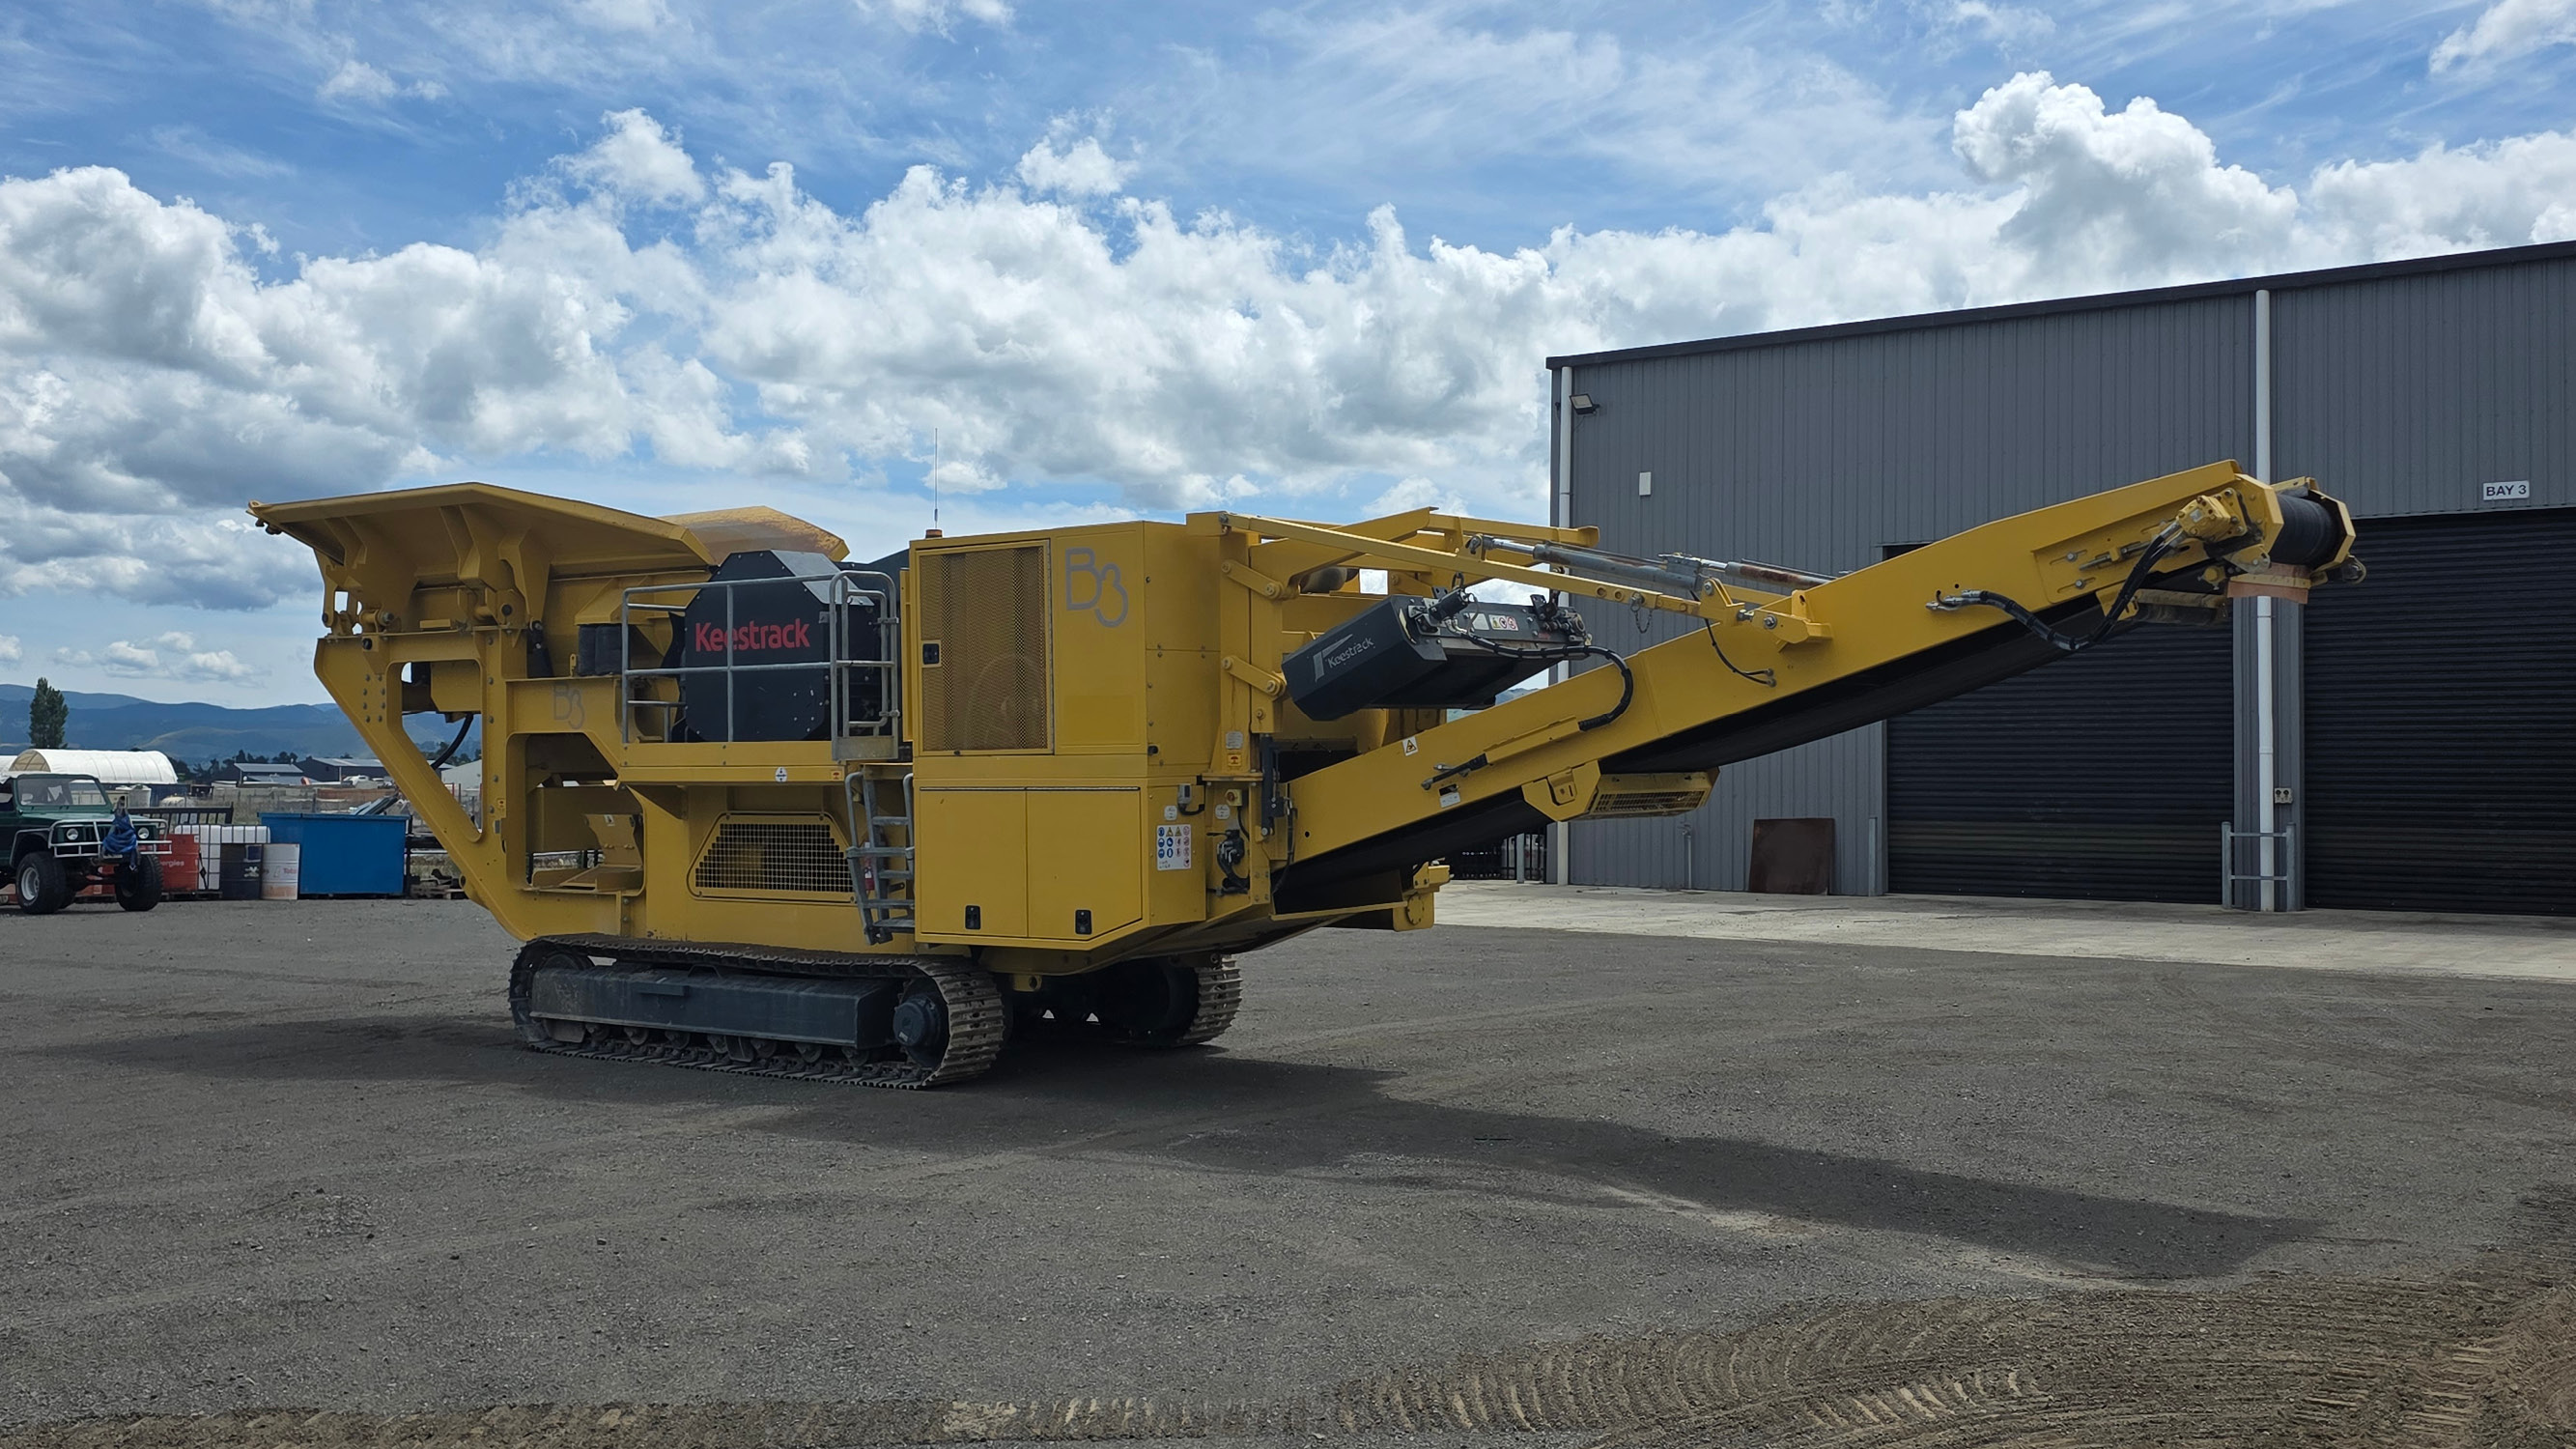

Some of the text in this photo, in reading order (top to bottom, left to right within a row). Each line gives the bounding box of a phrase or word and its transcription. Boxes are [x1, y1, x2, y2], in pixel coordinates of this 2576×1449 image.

[2486, 484, 2527, 497] BAY 3
[695, 618, 810, 652] Keestrack
[1327, 638, 1373, 668] Keestrack
